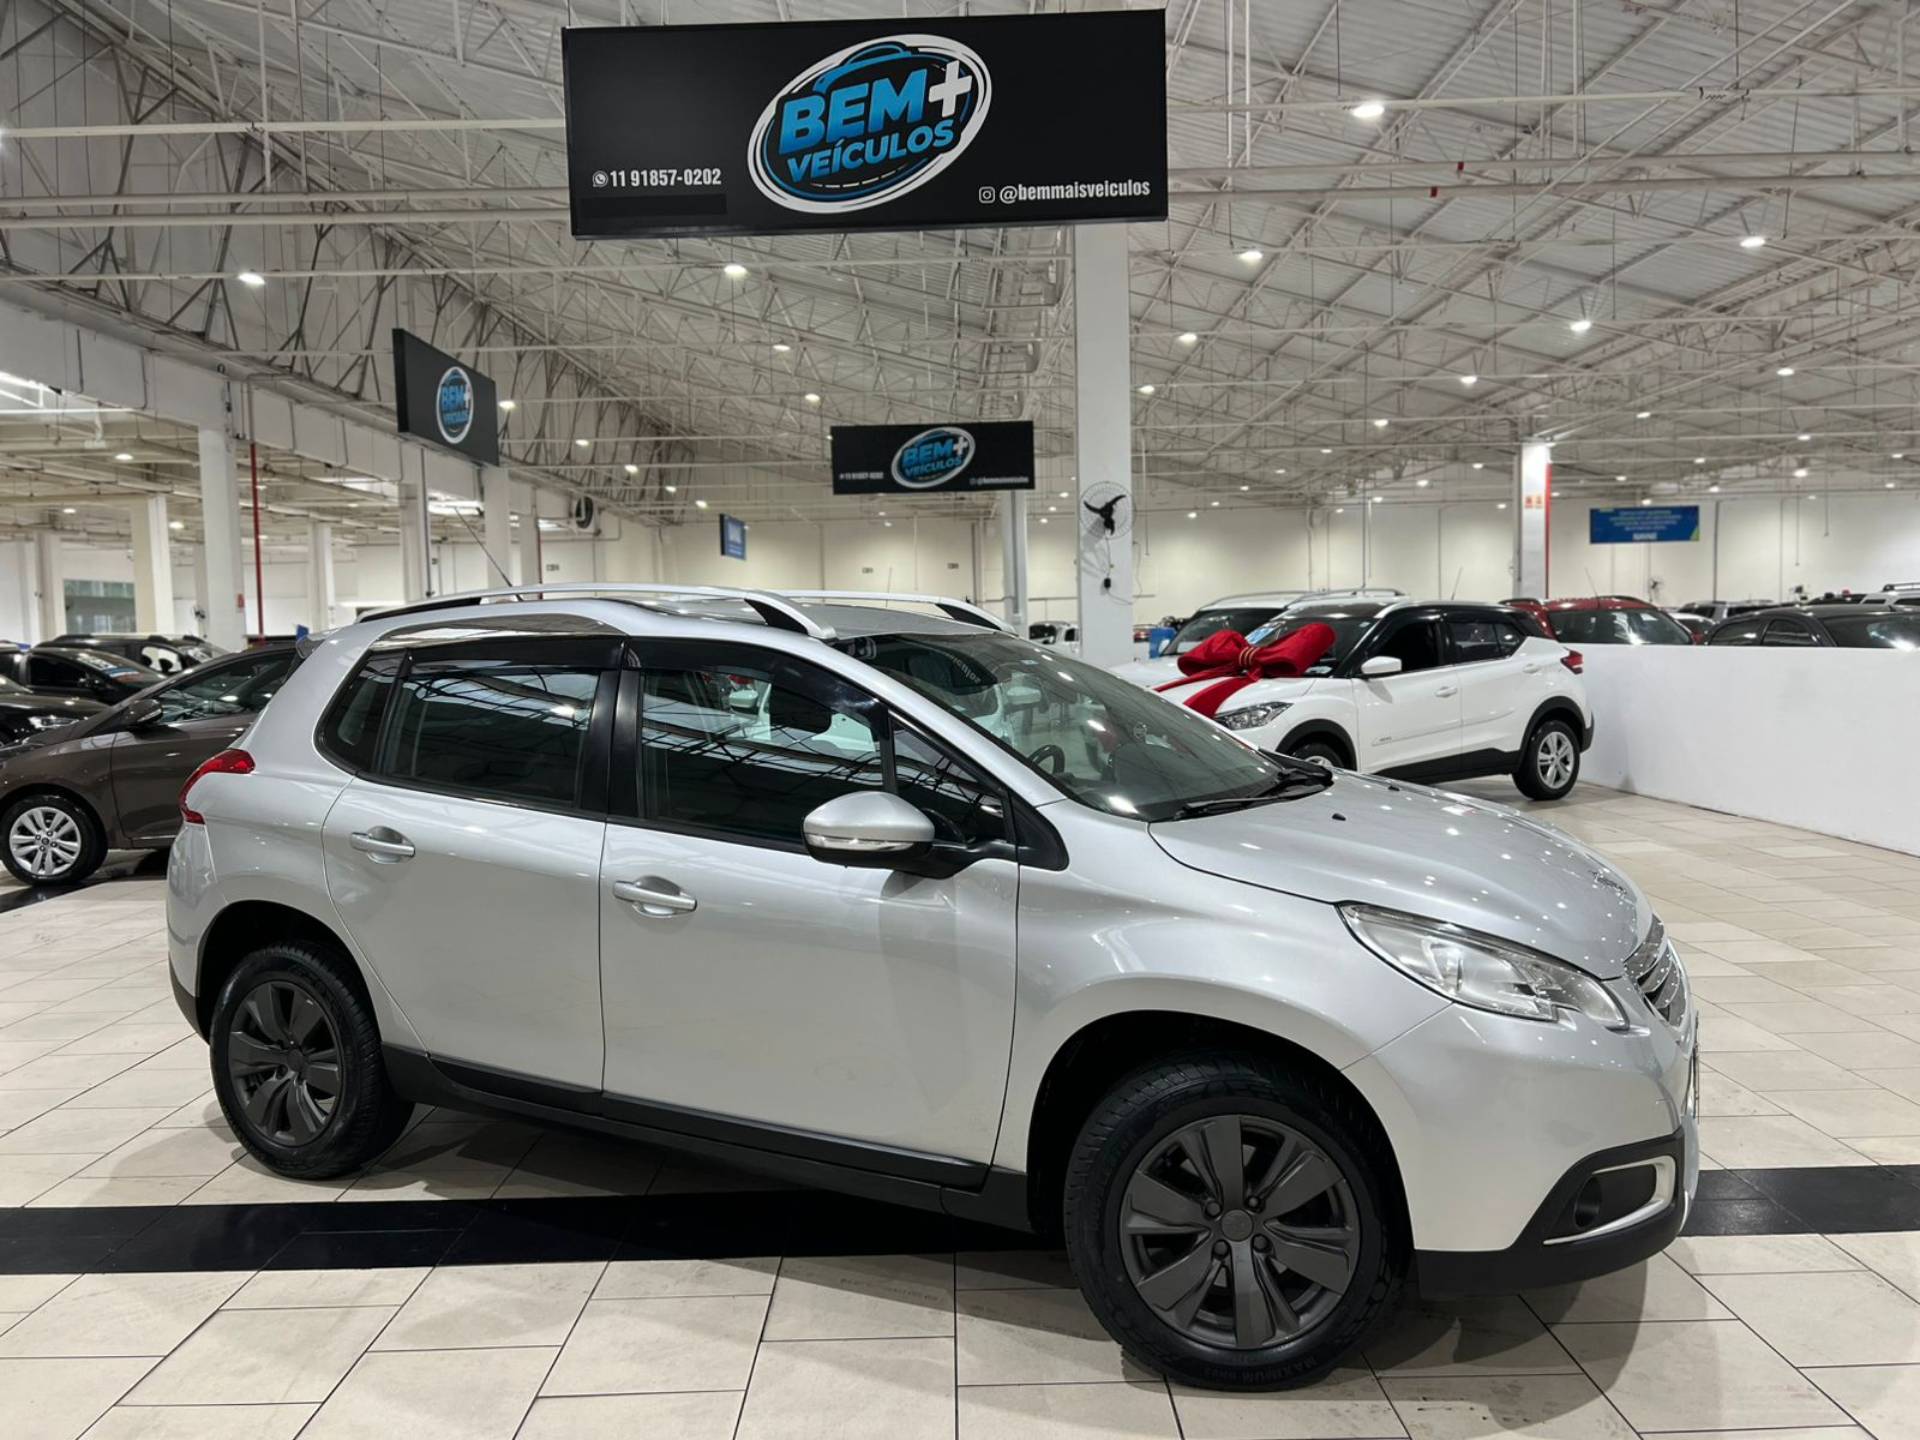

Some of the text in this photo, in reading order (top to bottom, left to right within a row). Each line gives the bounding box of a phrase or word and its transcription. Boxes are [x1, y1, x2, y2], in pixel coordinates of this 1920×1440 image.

[786, 118, 956, 183] VEÍCULOS
[609, 168, 722, 187] 11 91857-0202
[1000, 179, 1151, 204] @bemmaisveiculos
